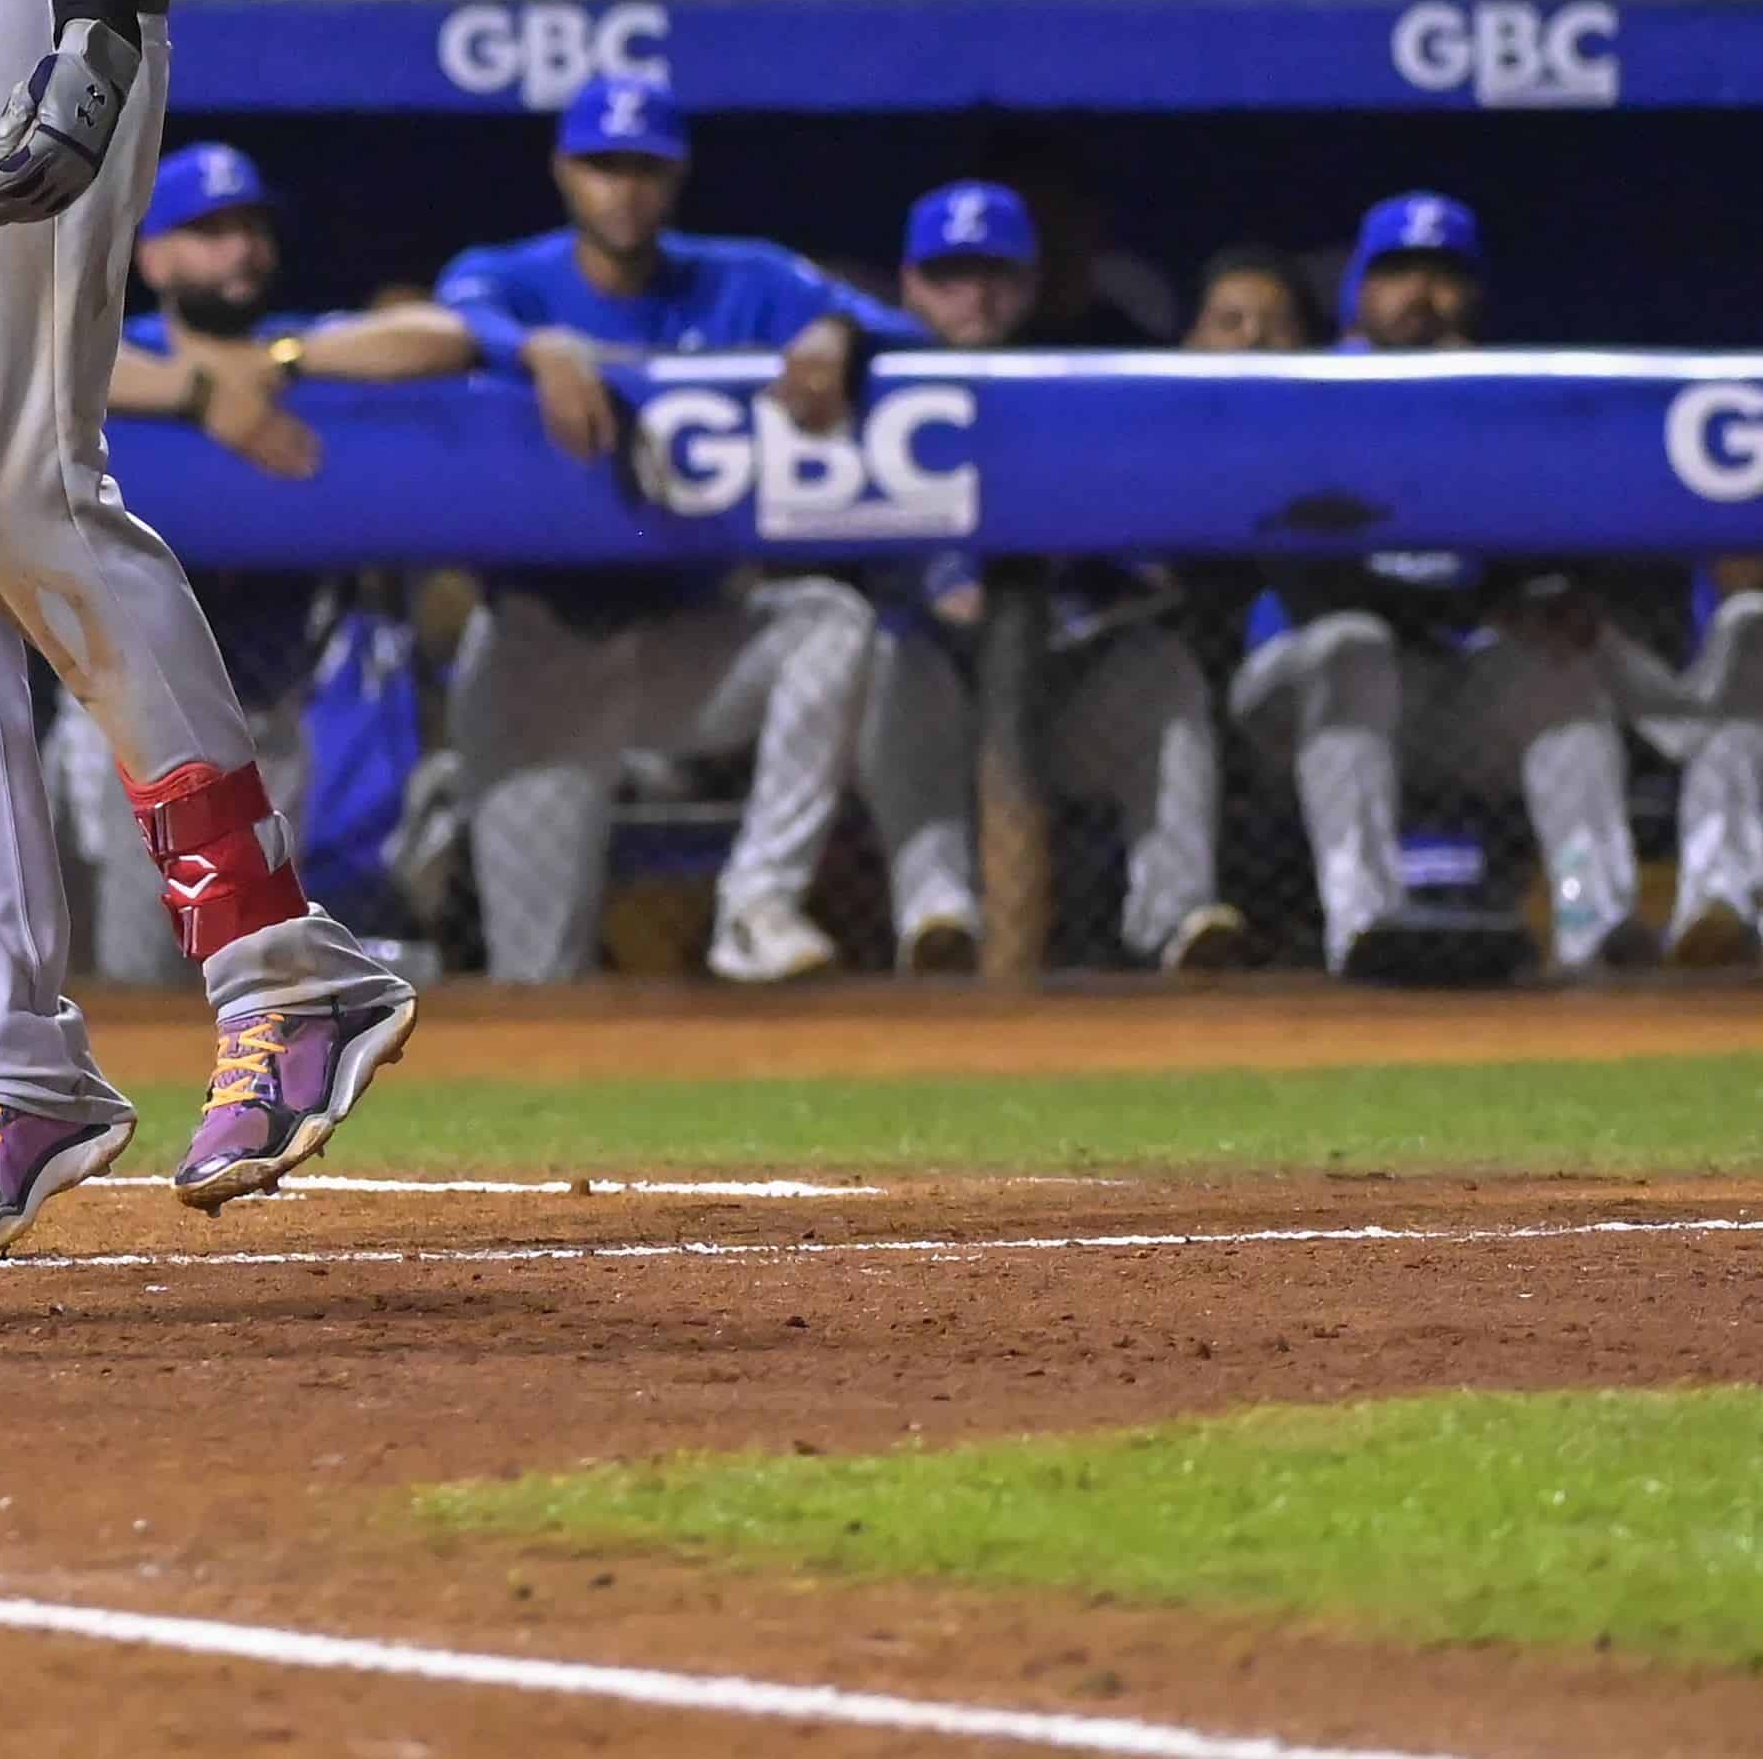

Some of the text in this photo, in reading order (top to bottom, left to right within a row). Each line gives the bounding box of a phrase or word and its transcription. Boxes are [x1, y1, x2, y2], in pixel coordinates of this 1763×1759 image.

[437, 1, 672, 111] GBC
[1390, 1, 1623, 109] GBC
[632, 386, 979, 540] GBC
